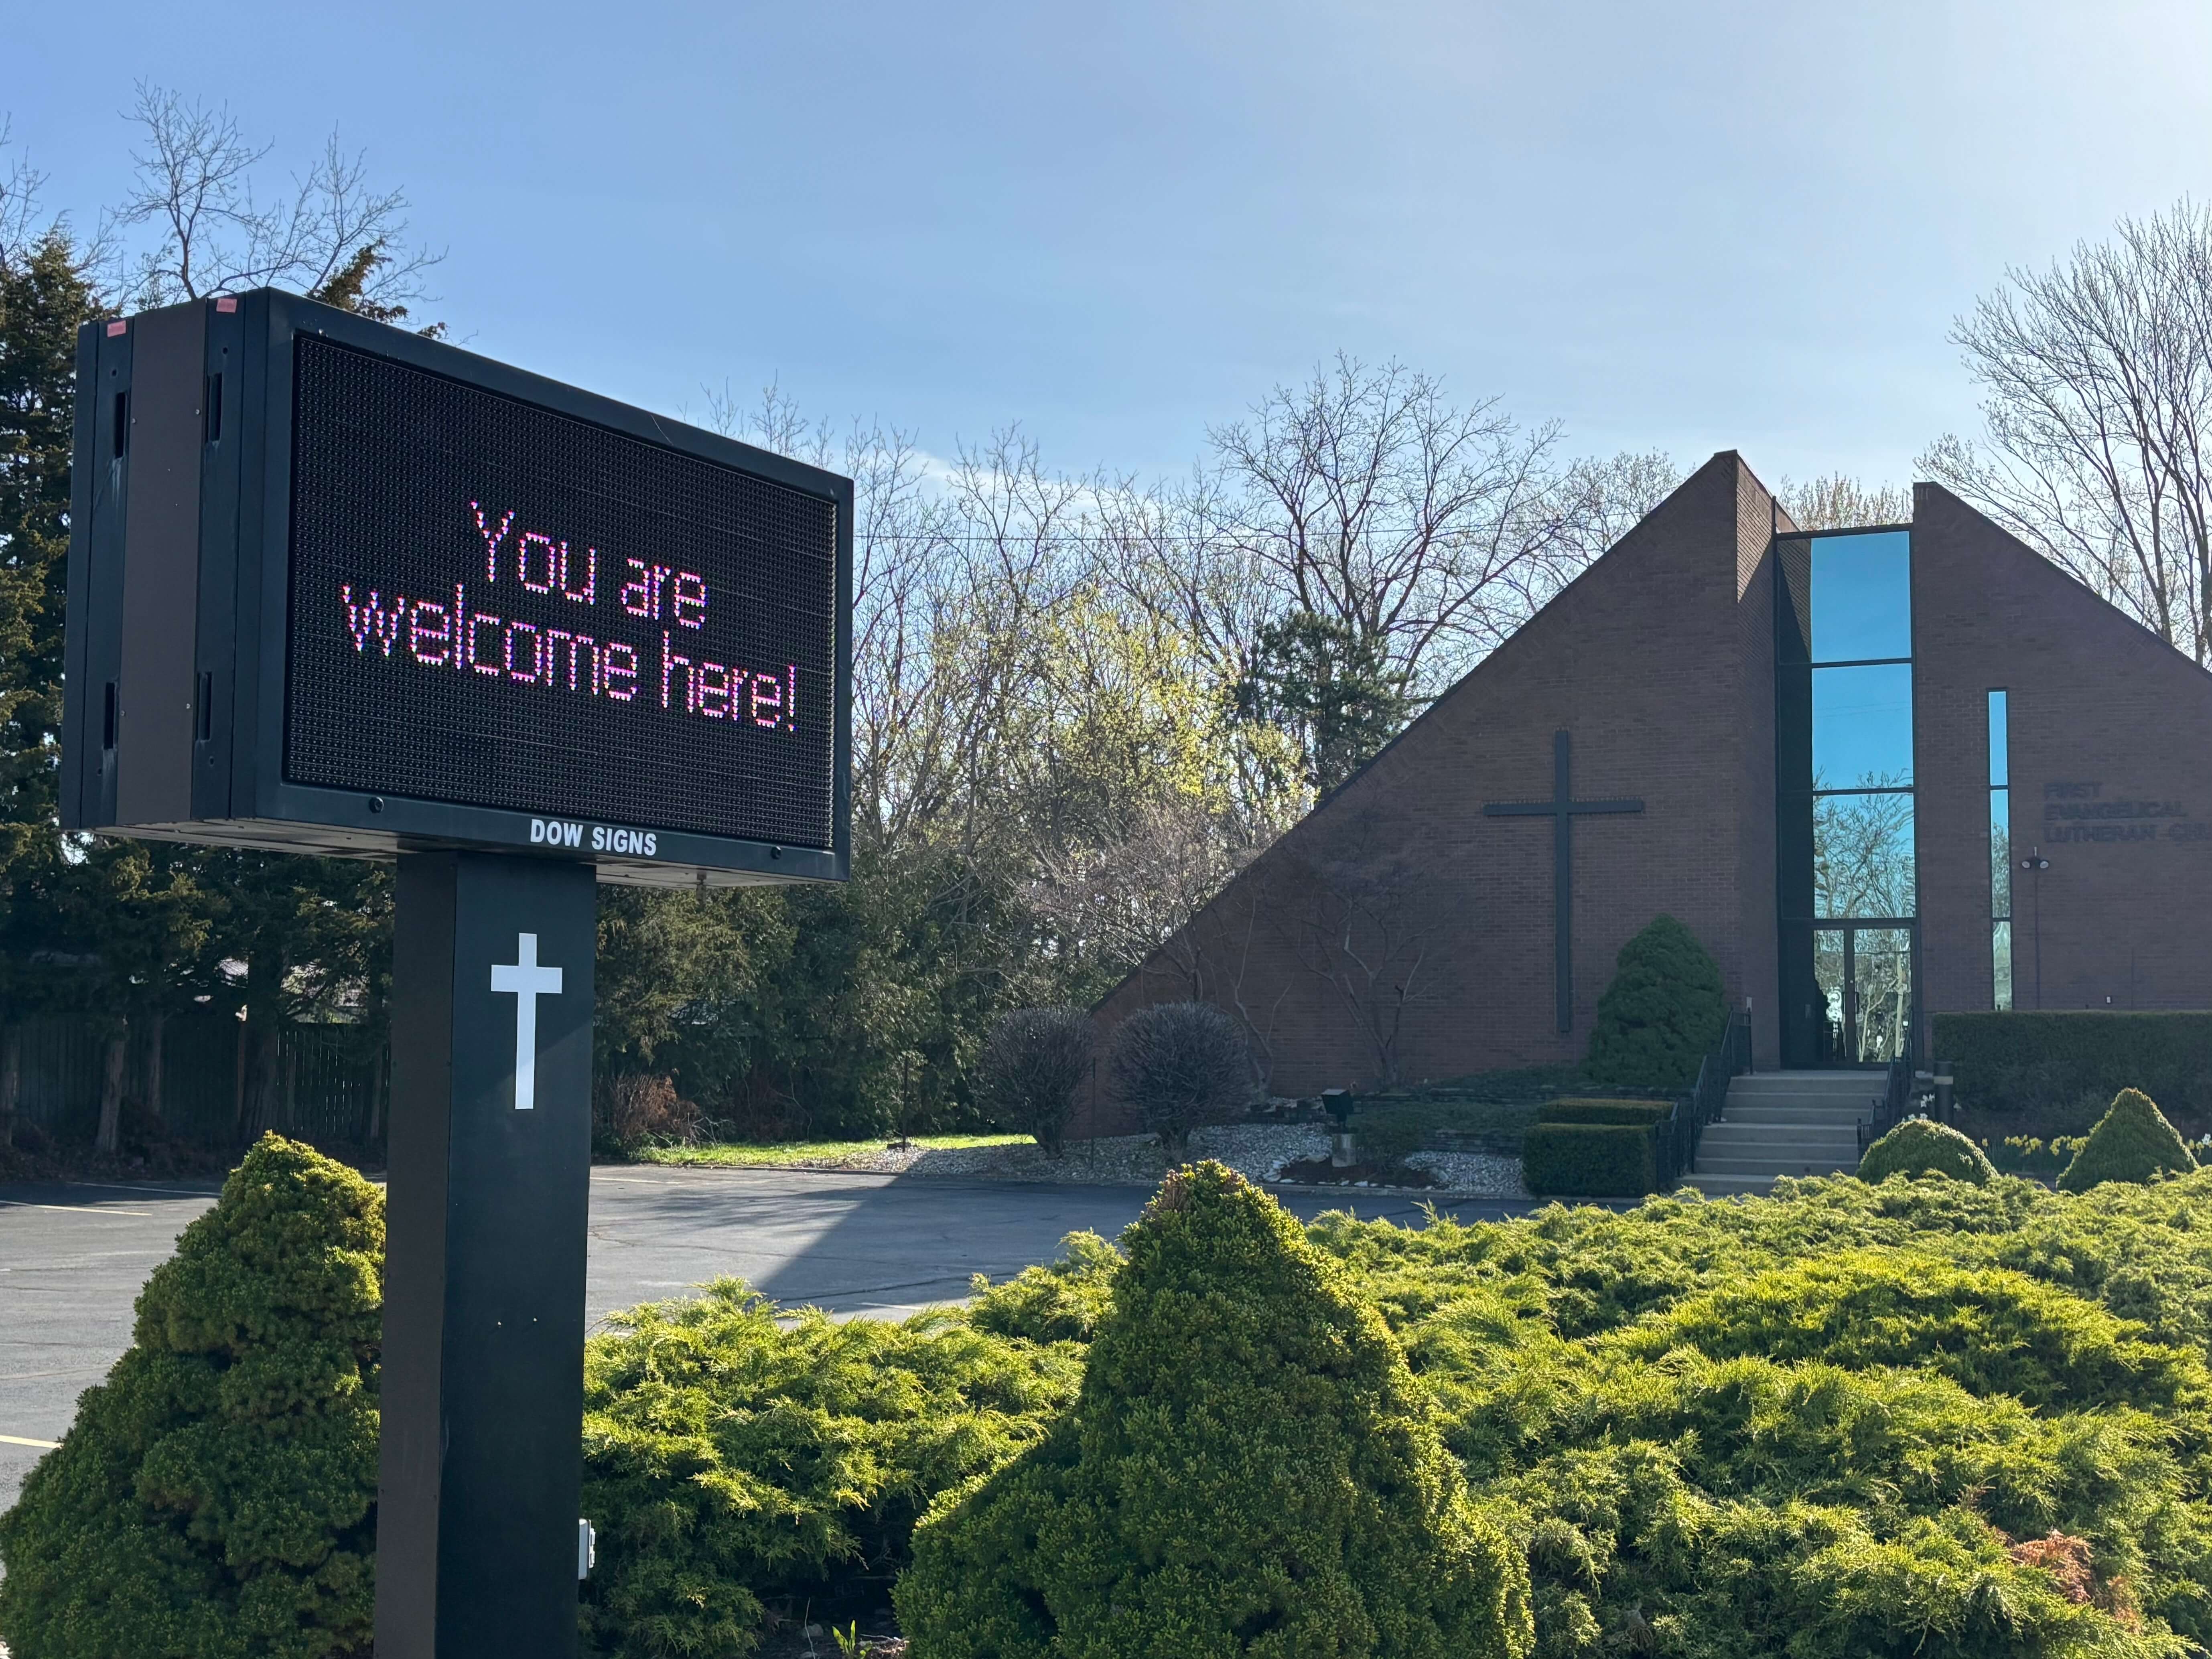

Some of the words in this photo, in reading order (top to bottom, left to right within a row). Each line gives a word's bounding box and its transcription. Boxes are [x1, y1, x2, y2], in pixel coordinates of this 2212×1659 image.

[471, 501, 595, 606] You
[621, 558, 706, 630] are
[661, 631, 796, 732] here!
[530, 819, 583, 847] DOW
[591, 827, 657, 856] SIGNS
